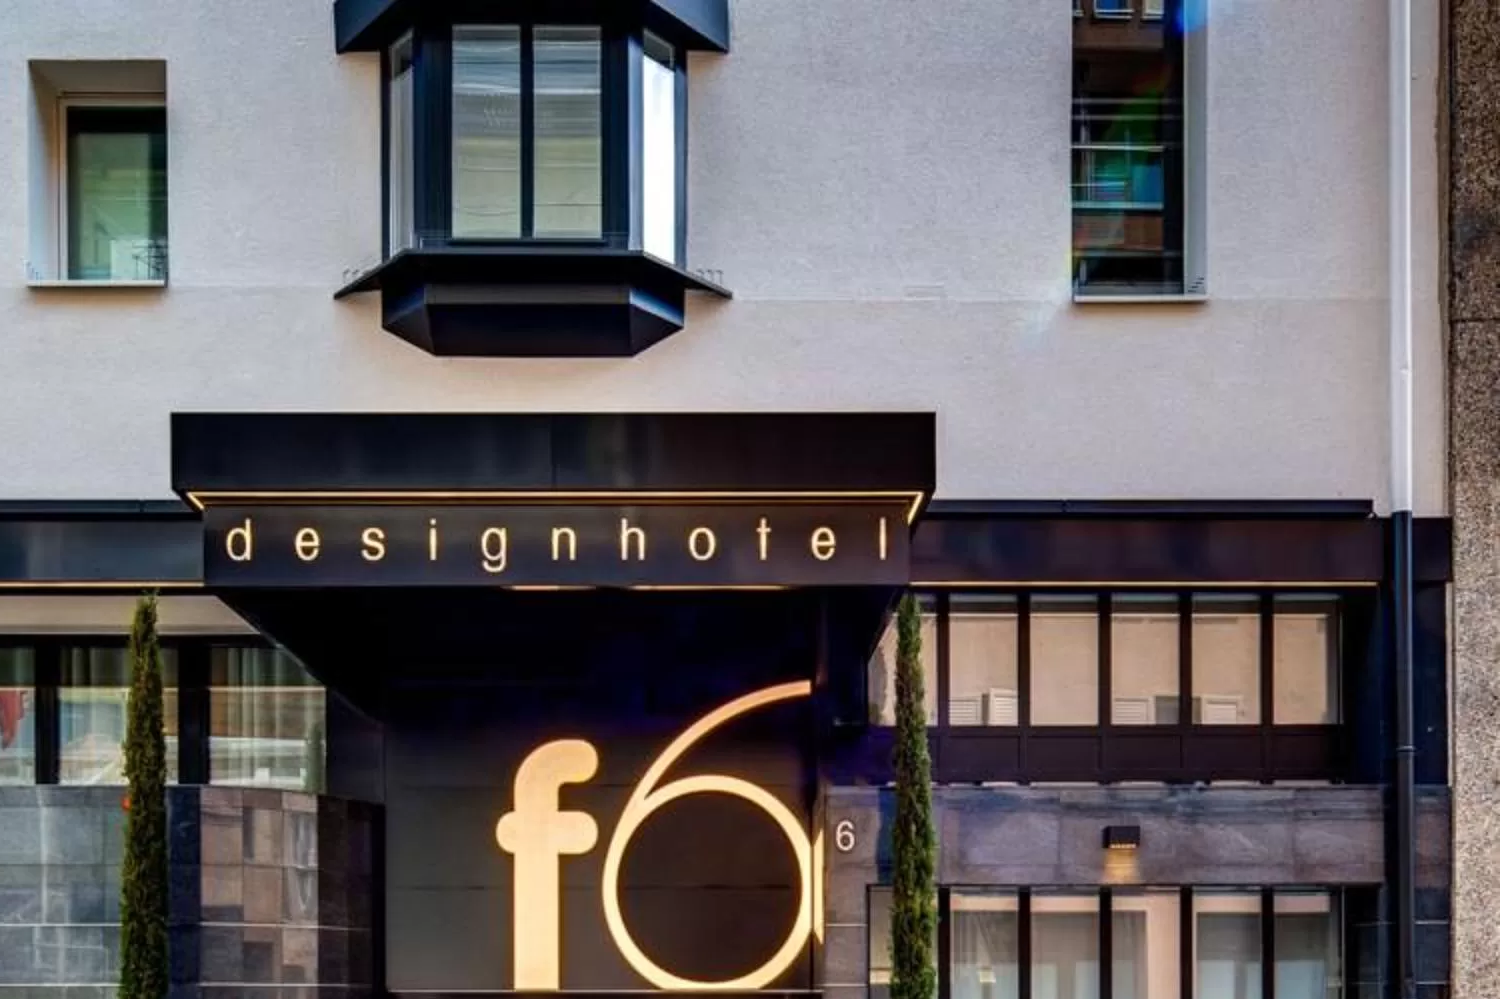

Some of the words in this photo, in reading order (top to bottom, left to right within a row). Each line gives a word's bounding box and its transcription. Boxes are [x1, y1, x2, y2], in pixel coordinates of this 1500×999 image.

[225, 517, 887, 572] designhotel
[495, 679, 812, 992] f6
[836, 819, 855, 851] 6
